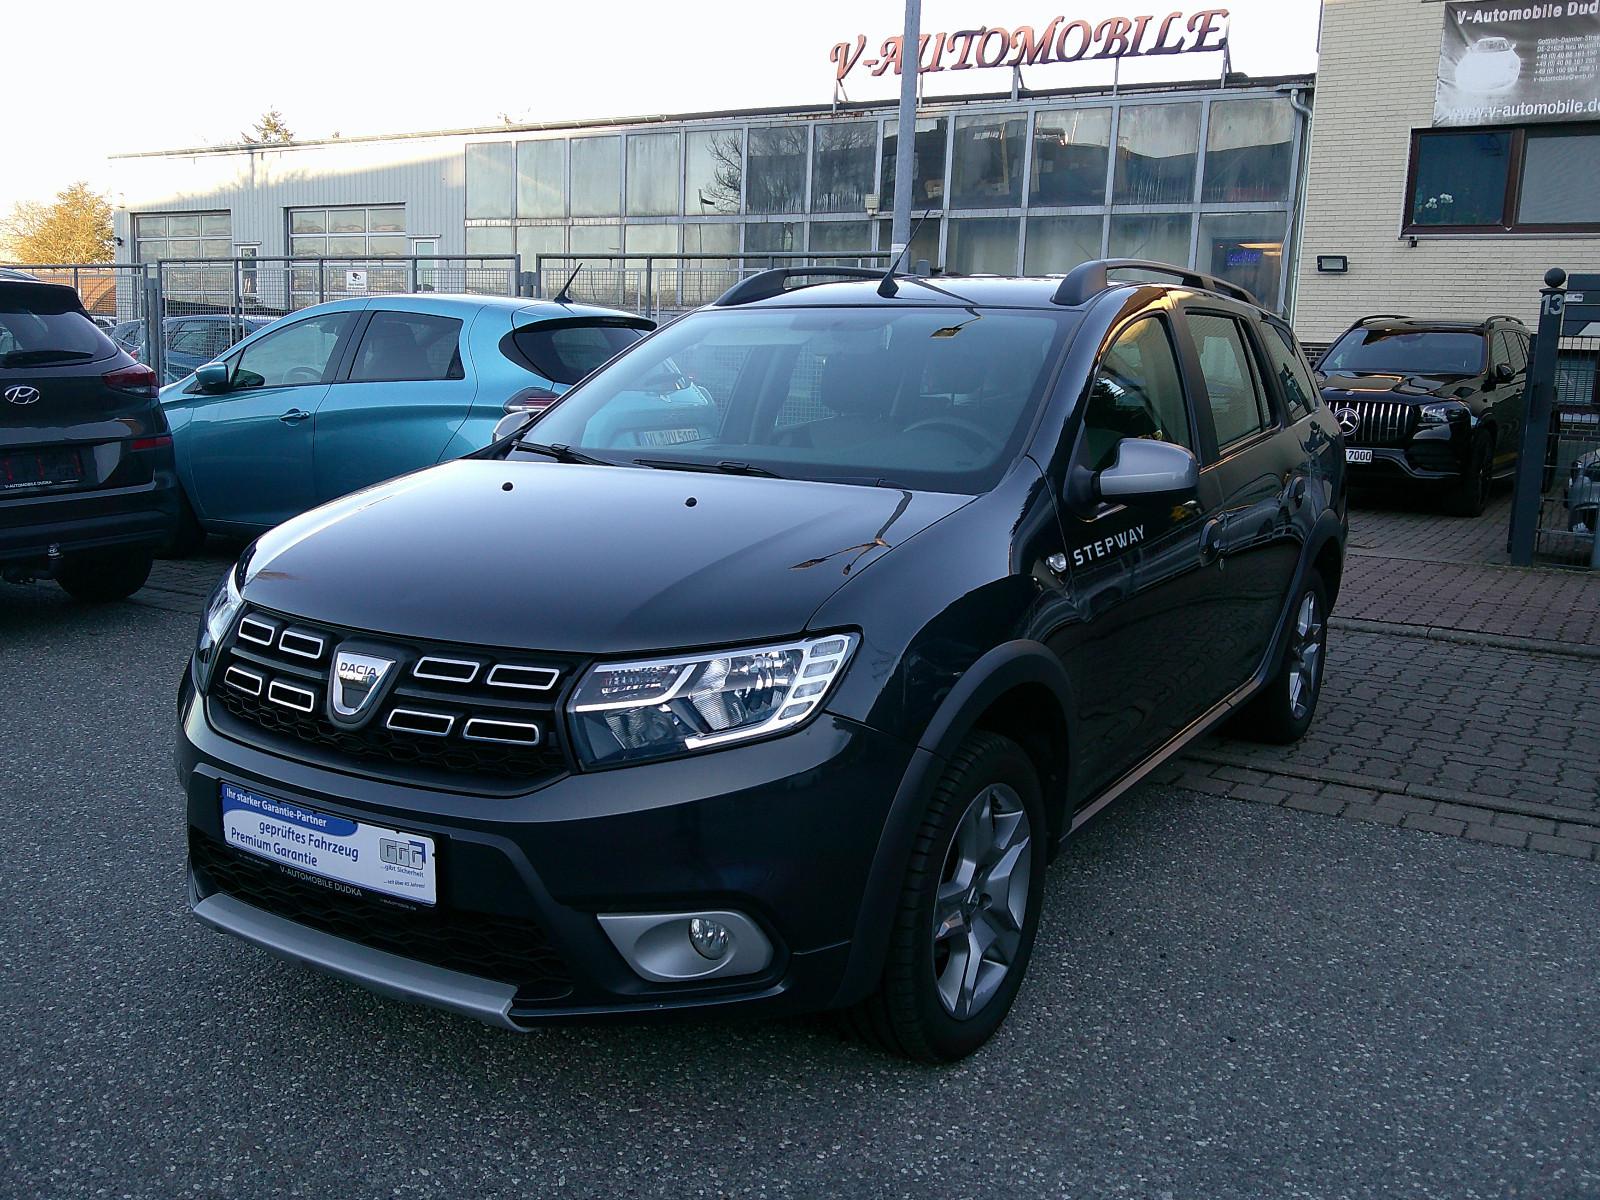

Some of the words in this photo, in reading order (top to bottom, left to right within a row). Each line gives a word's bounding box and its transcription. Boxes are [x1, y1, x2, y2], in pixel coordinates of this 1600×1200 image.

[1457, 4, 1563, 25] V-Automobile
[830, 8, 1230, 81] V-AUTOMOBILE
[1541, 294, 1564, 315] 13
[1348, 450, 1371, 461] 7000
[1073, 524, 1144, 566] STEPWAY
[340, 662, 377, 677] DACIA
[226, 788, 236, 800] Ihr
[236, 792, 261, 808] starker
[261, 800, 327, 828] Garantie-Partner
[231, 826, 272, 853] Premium
[273, 843, 318, 867] Garantie
[259, 821, 306, 845] geprüftes
[308, 833, 360, 863] Fahrzeug
[279, 866, 333, 889] V-AUTOMOBILE
[334, 882, 363, 897] DUDKA
[397, 867, 424, 878] Sicherheit
